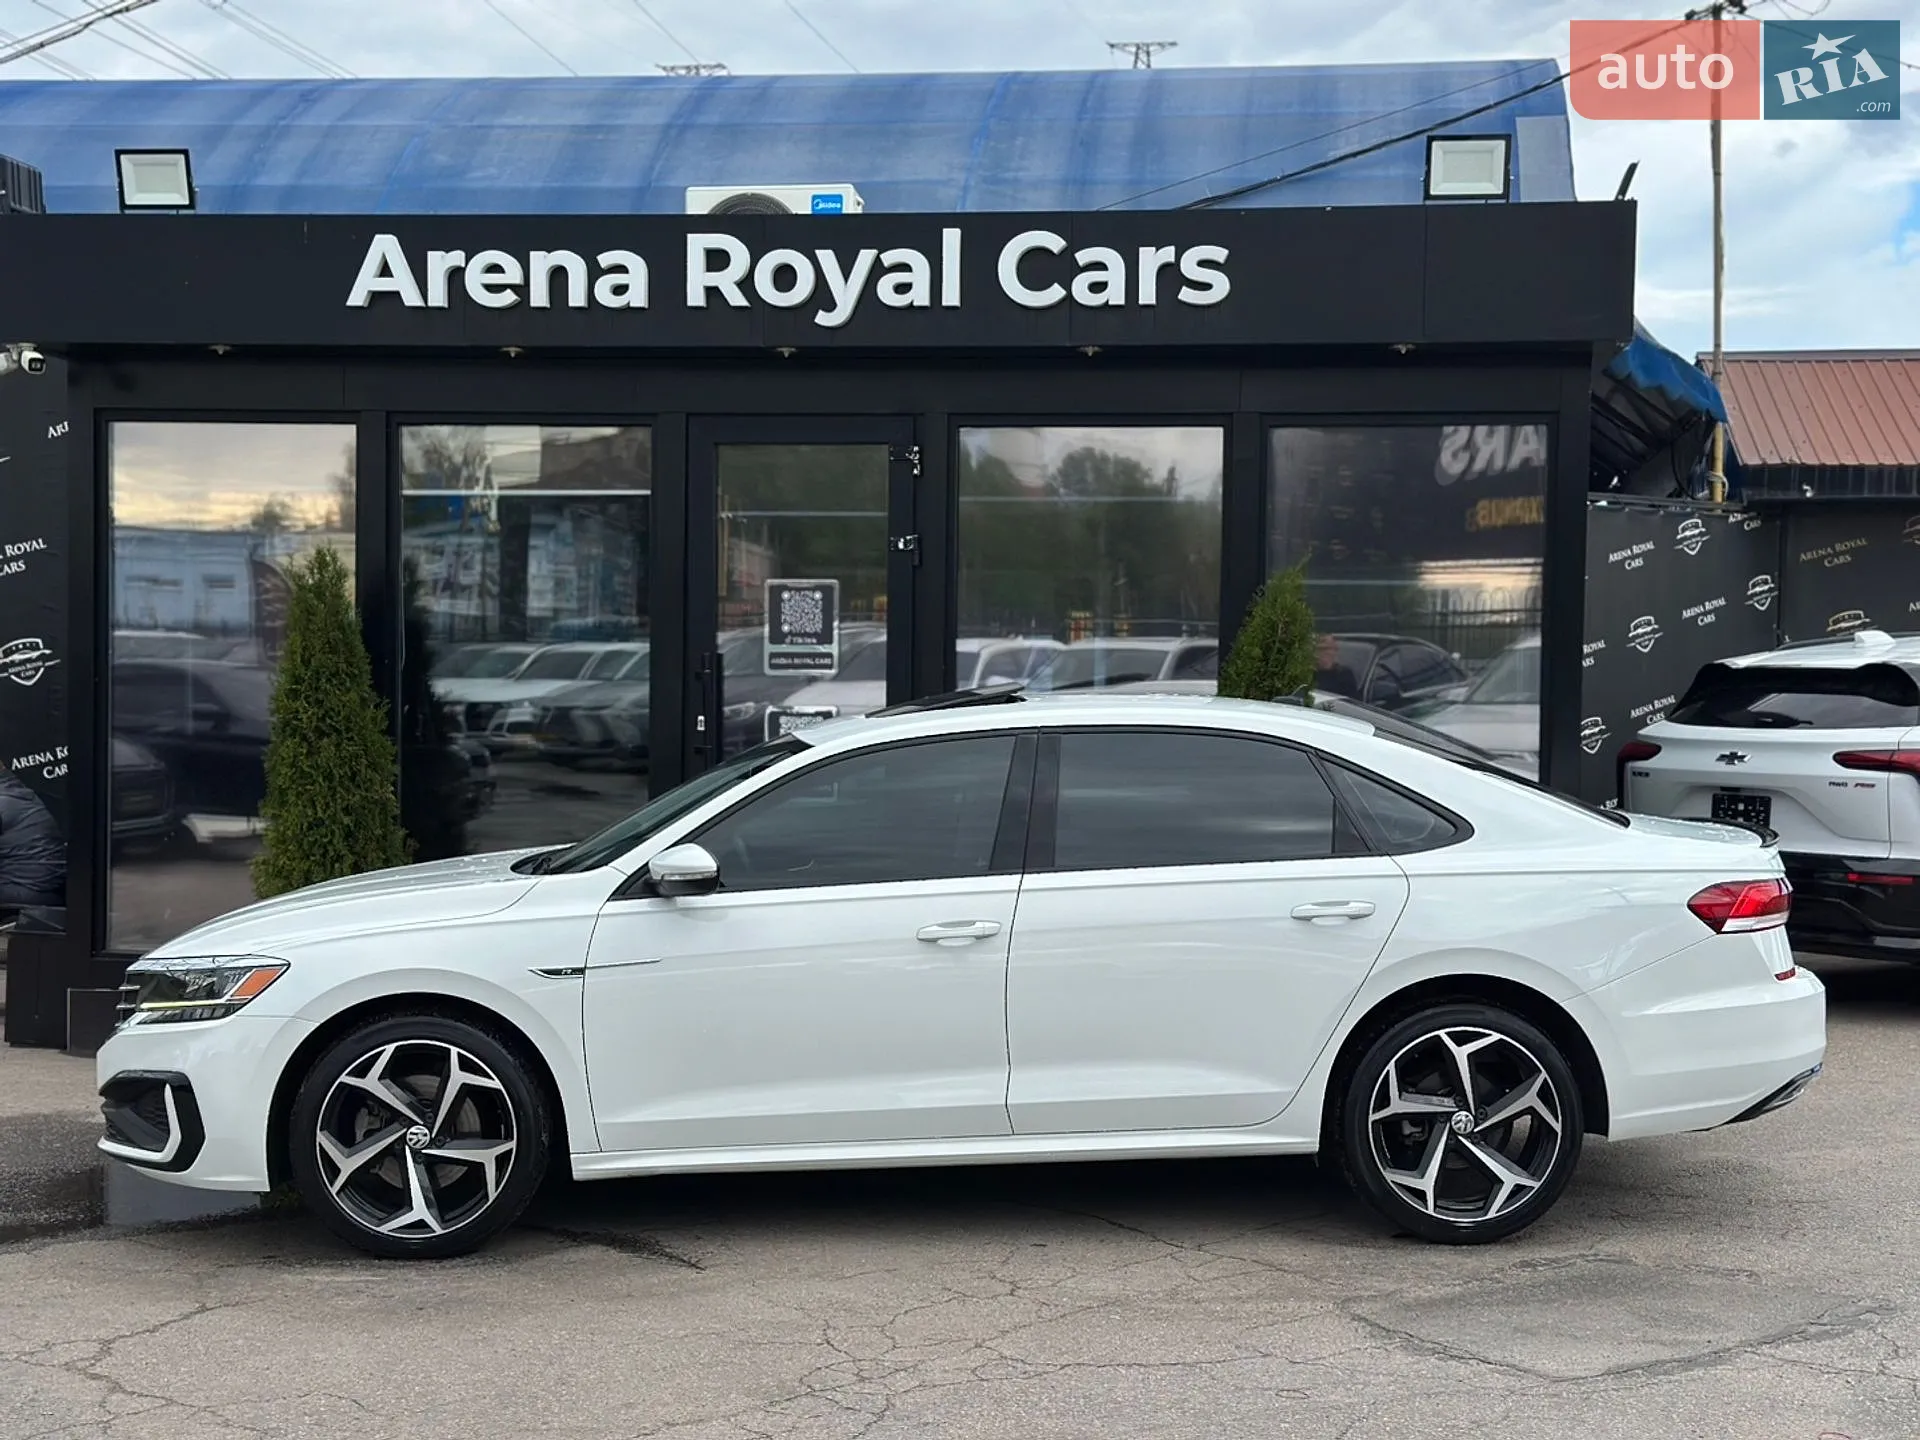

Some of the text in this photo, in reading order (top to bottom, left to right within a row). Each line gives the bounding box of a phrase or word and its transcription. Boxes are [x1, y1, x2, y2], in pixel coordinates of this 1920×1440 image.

[346, 228, 1230, 327] Arena Royal Cars
[48, 421, 69, 438] AR
[4, 538, 48, 557] ROYAL
[1608, 540, 1655, 564] ARENA ROYAL
[1800, 538, 1868, 562] ARENA ROYAL
[1624, 557, 1644, 570] CARS
[1823, 555, 1851, 567] CARS
[1682, 596, 1727, 620] ARENA ROYAL
[1697, 613, 1716, 626] CARS
[1630, 695, 1676, 719] ARENA ROYAL
[12, 752, 54, 770] ARENA
